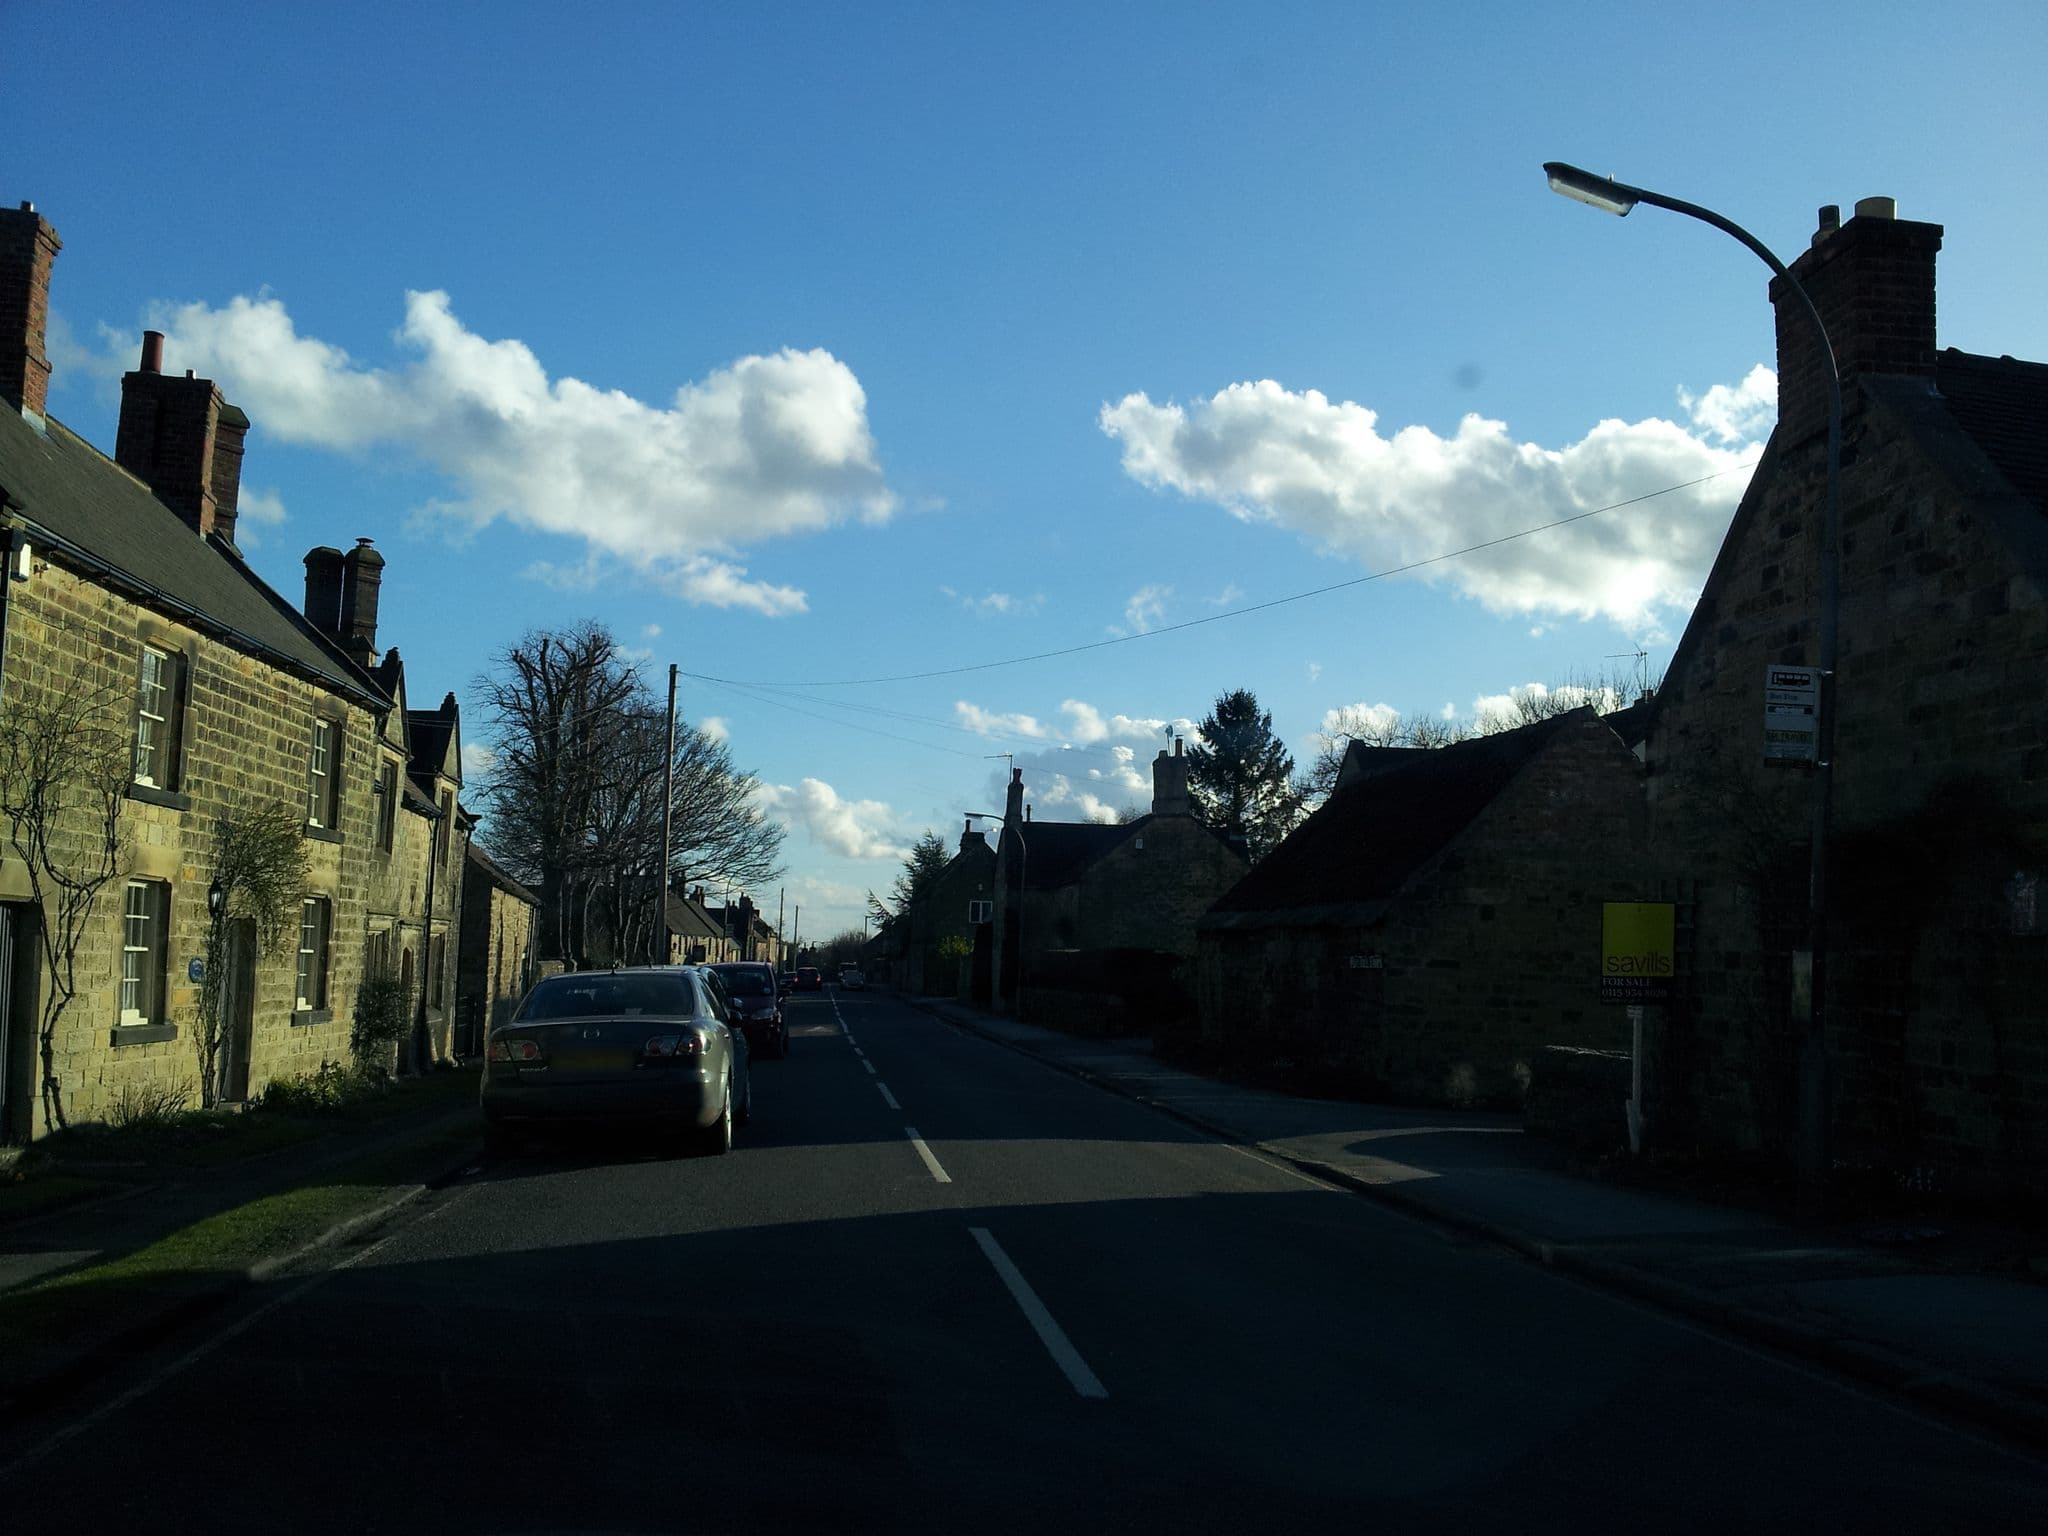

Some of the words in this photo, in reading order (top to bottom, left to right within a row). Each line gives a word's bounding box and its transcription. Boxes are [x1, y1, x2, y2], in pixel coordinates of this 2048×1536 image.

[1607, 951, 1670, 973] savills
[1602, 977, 1624, 986] FOR
[1625, 977, 1653, 987] SALE
